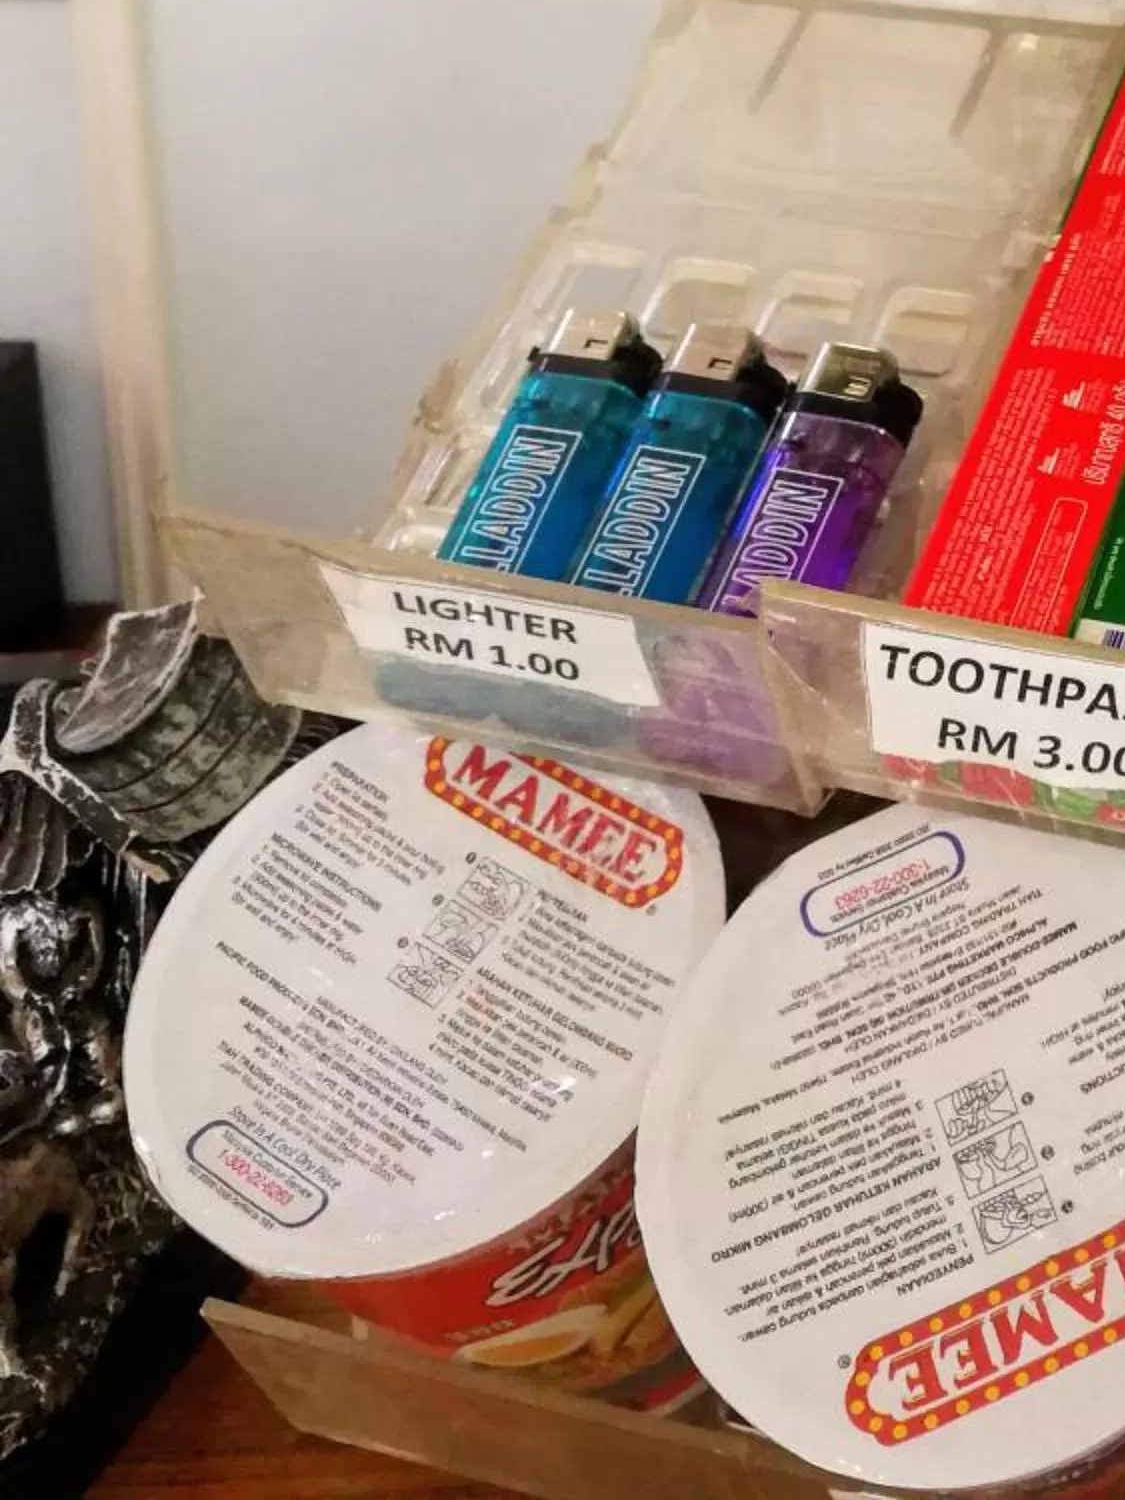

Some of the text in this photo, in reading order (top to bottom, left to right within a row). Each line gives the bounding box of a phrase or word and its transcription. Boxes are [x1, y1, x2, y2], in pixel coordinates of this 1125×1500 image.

[460, 438, 568, 573] LADDIN
[584, 456, 692, 597] LADDIN
[728, 481, 827, 598] ADDIN
[395, 592, 578, 643] LIGHTER
[404, 627, 580, 681] RM 1.00
[938, 717, 1018, 761] RM
[457, 749, 649, 878] MAMEE
